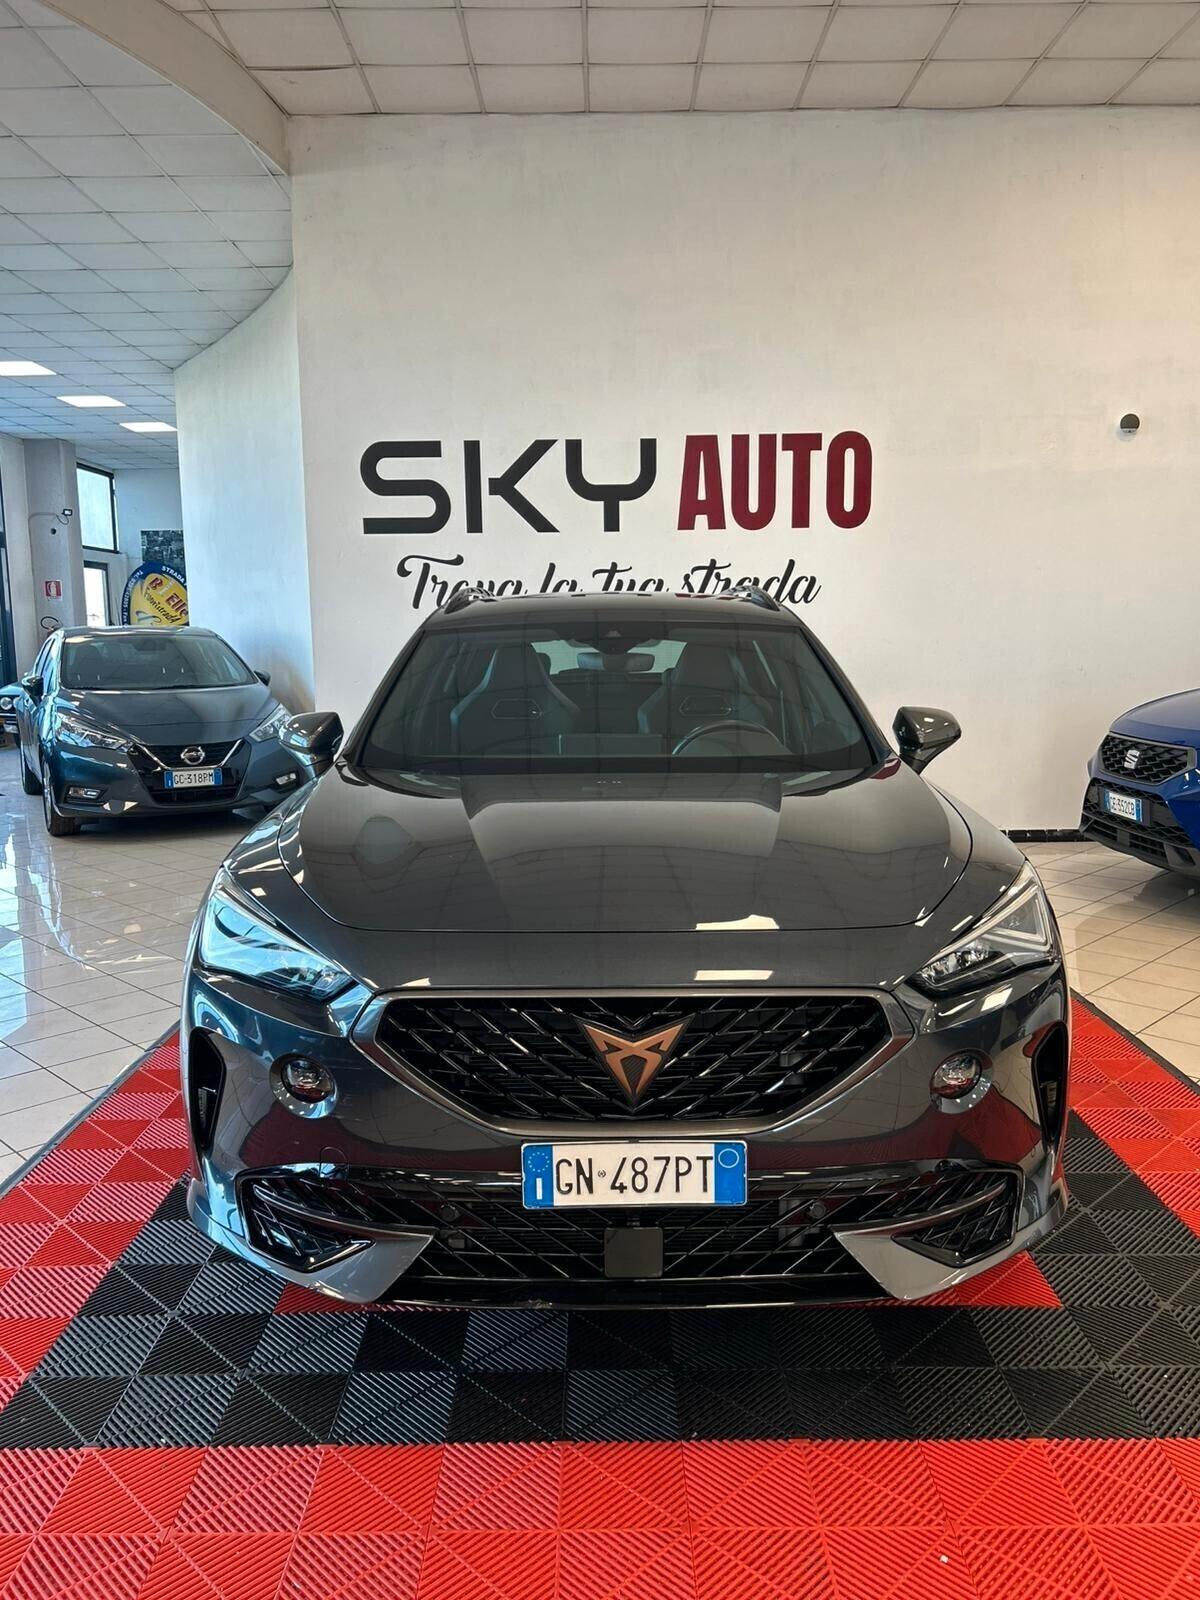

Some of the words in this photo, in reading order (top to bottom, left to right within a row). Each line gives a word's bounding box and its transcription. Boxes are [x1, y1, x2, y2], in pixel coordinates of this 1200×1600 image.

[360, 438, 657, 535] SKY
[677, 430, 873, 530] AUTO
[556, 1157, 594, 1195] GN
[610, 1156, 713, 1194] 487PT
